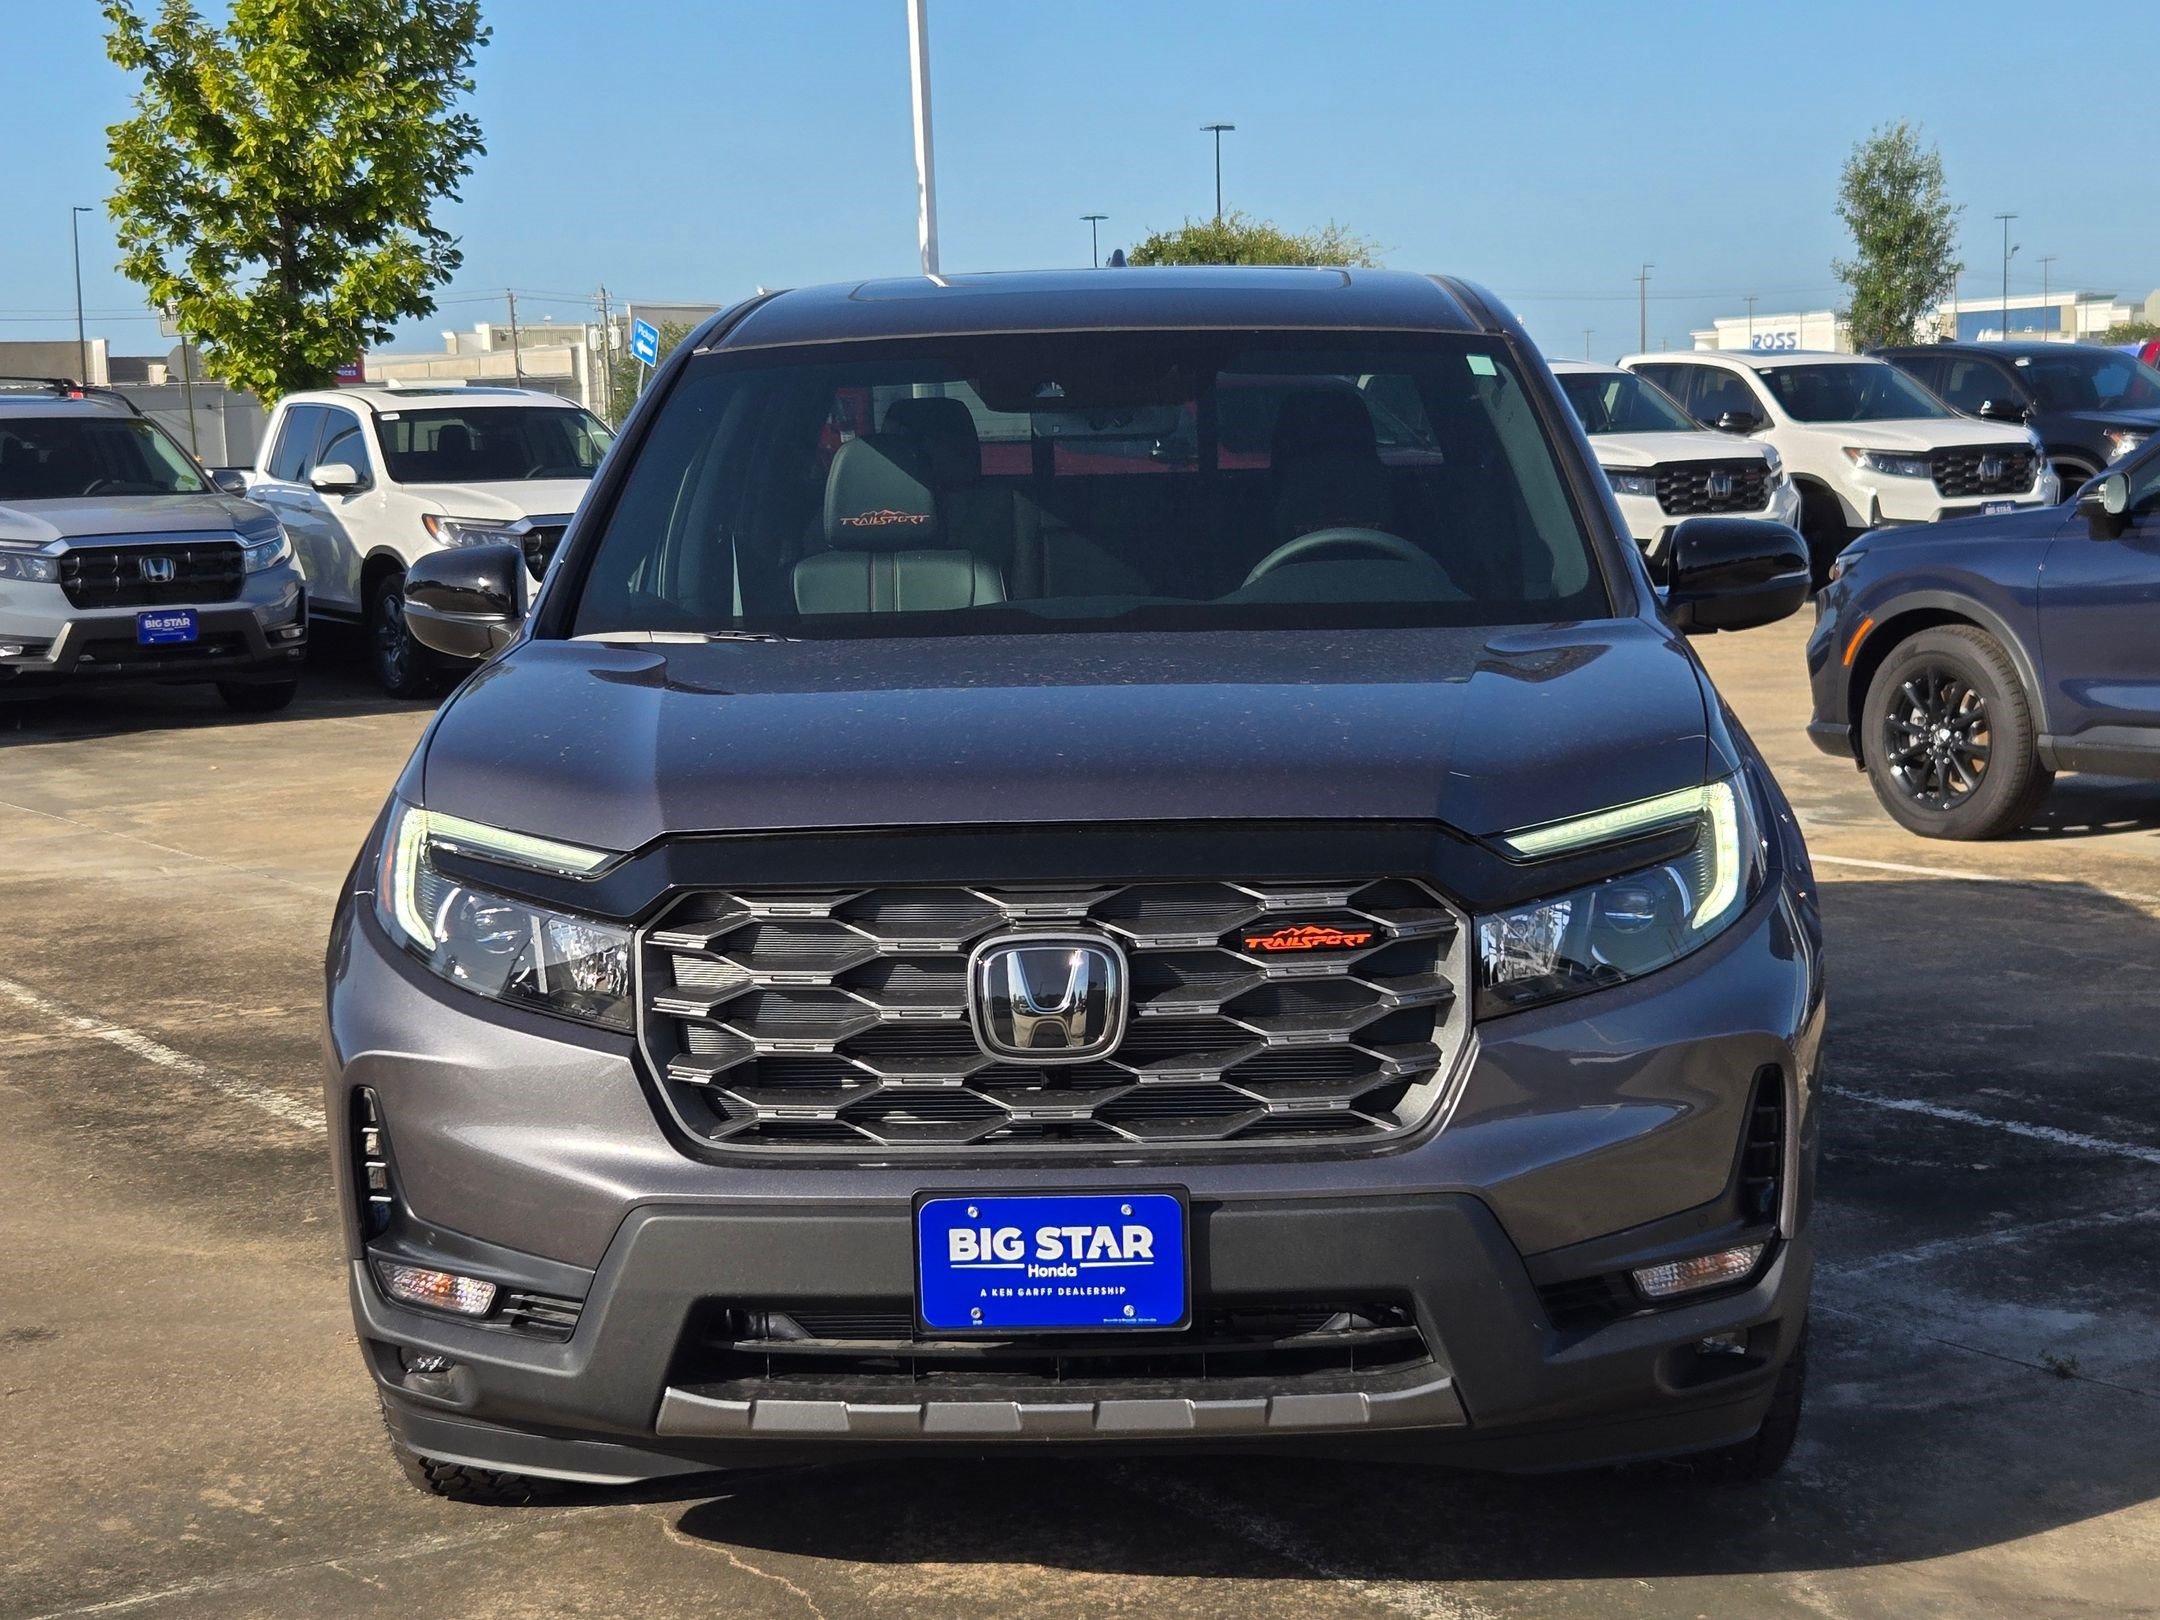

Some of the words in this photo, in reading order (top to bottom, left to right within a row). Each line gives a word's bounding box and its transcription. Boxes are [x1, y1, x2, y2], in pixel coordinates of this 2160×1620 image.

[1752, 332, 1797, 350] ROSS
[840, 515, 930, 526] TRAILSPORT
[145, 619, 162, 629] BIG
[163, 617, 190, 627] STAR
[1244, 933, 1372, 950] TRAILSPORT
[949, 1227, 1024, 1261] BIG
[1035, 1225, 1154, 1260] STAR
[1028, 1262, 1077, 1278] Honda
[980, 1289, 987, 1297] A
[992, 1288, 1013, 1297] KEN
[1017, 1287, 1053, 1297] GARFF
[1057, 1286, 1126, 1296] DEALERSHIP
